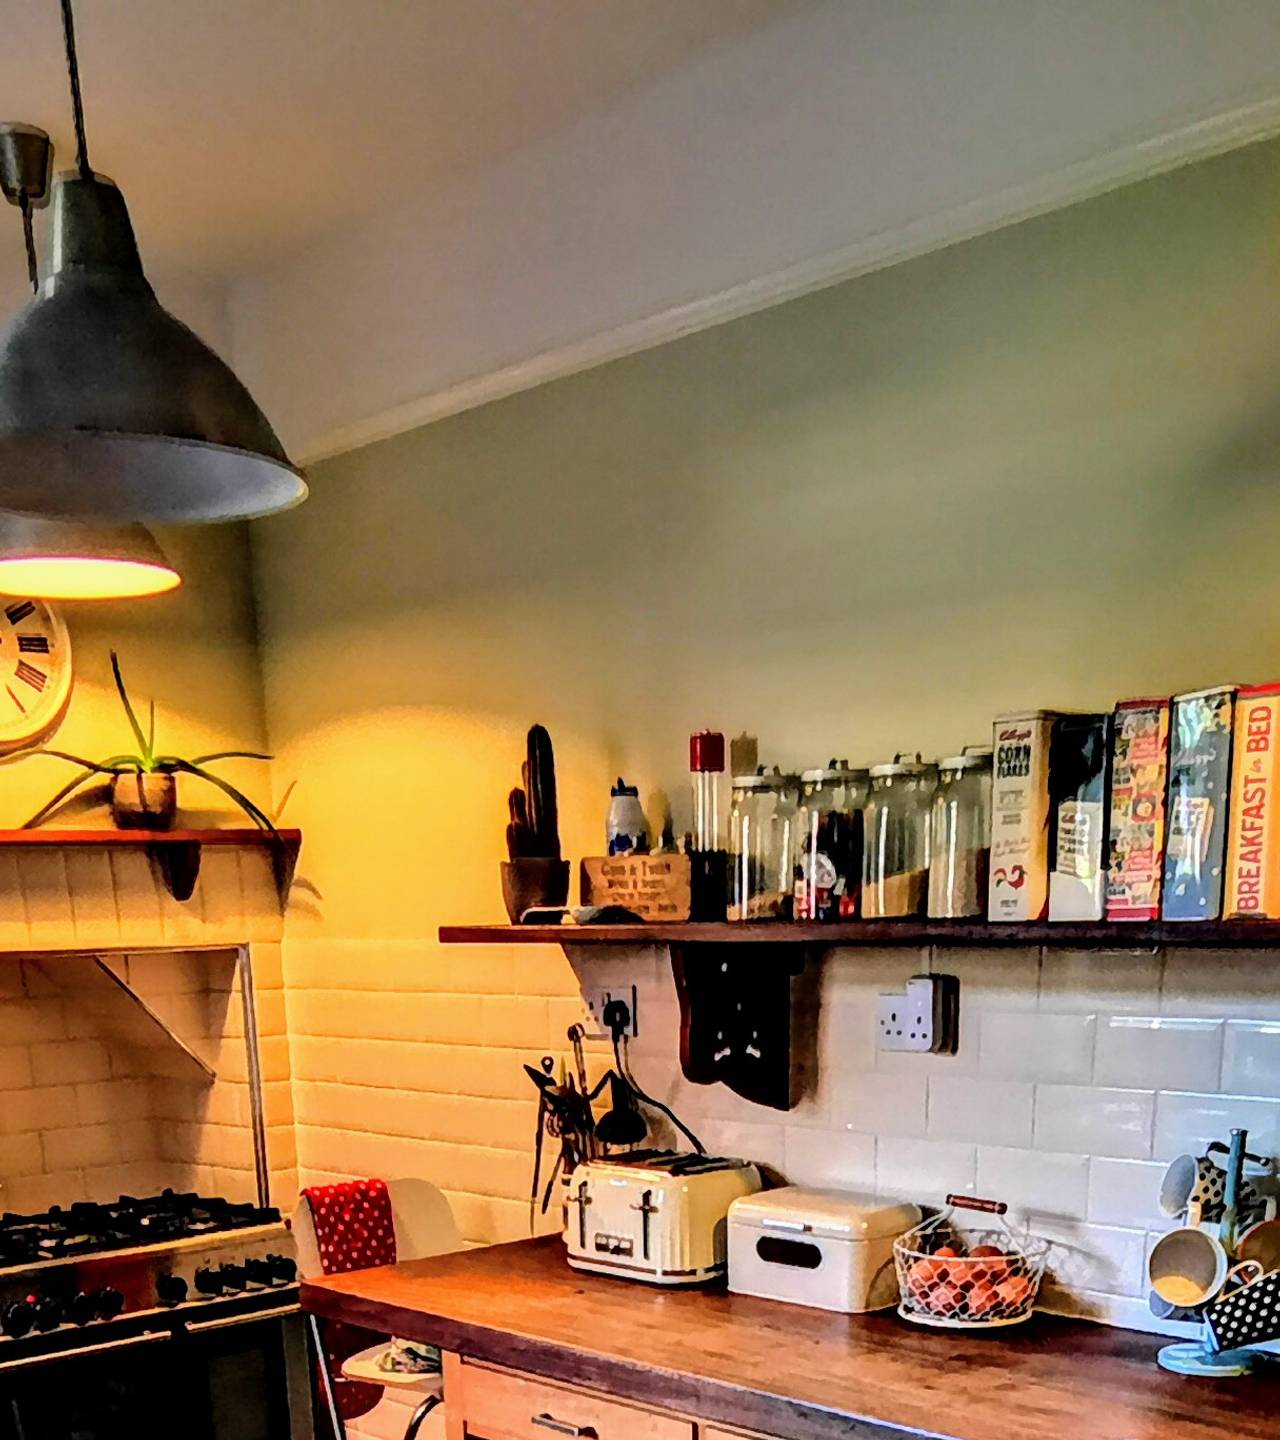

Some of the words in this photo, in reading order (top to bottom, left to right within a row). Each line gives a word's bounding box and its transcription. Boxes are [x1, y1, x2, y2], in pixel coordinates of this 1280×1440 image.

[1246, 705, 1273, 753] BED
[997, 744, 1032, 763] CORN
[996, 763, 1030, 780] FLAKES
[1236, 774, 1267, 913] BREAKFAST
